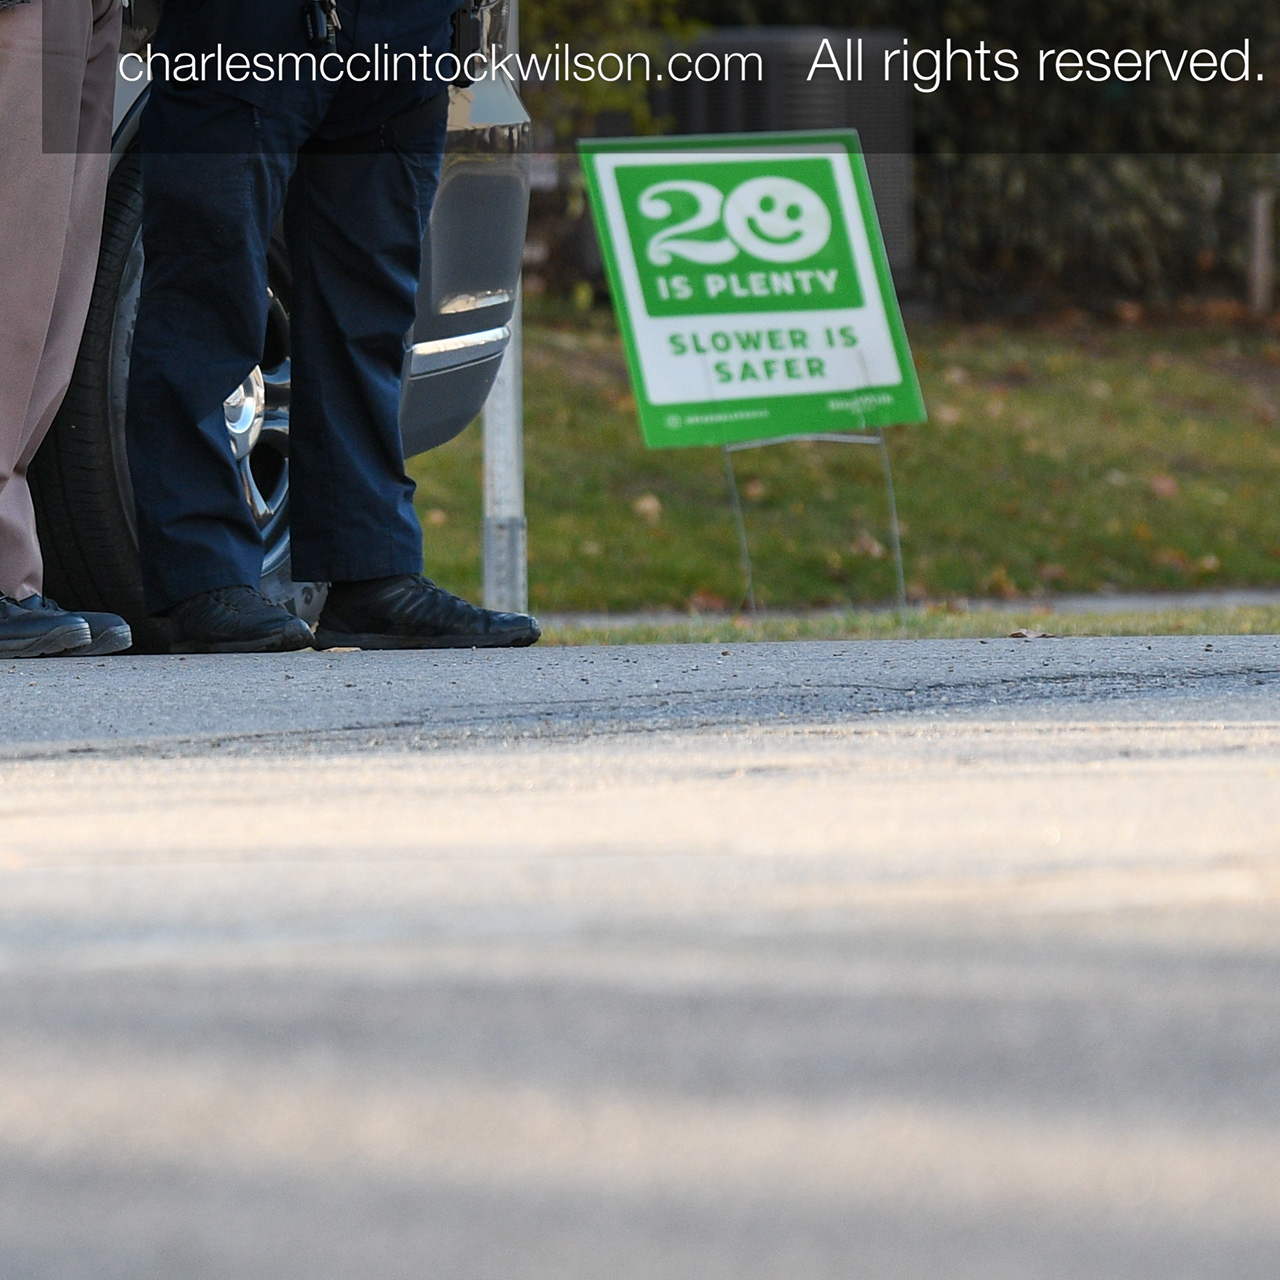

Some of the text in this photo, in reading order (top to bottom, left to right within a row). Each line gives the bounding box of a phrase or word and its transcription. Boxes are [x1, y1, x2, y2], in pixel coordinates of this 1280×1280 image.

[658, 269, 839, 299] IS PLENTY
[669, 325, 858, 356] SLOWER IS
[715, 357, 827, 384] SAFER
